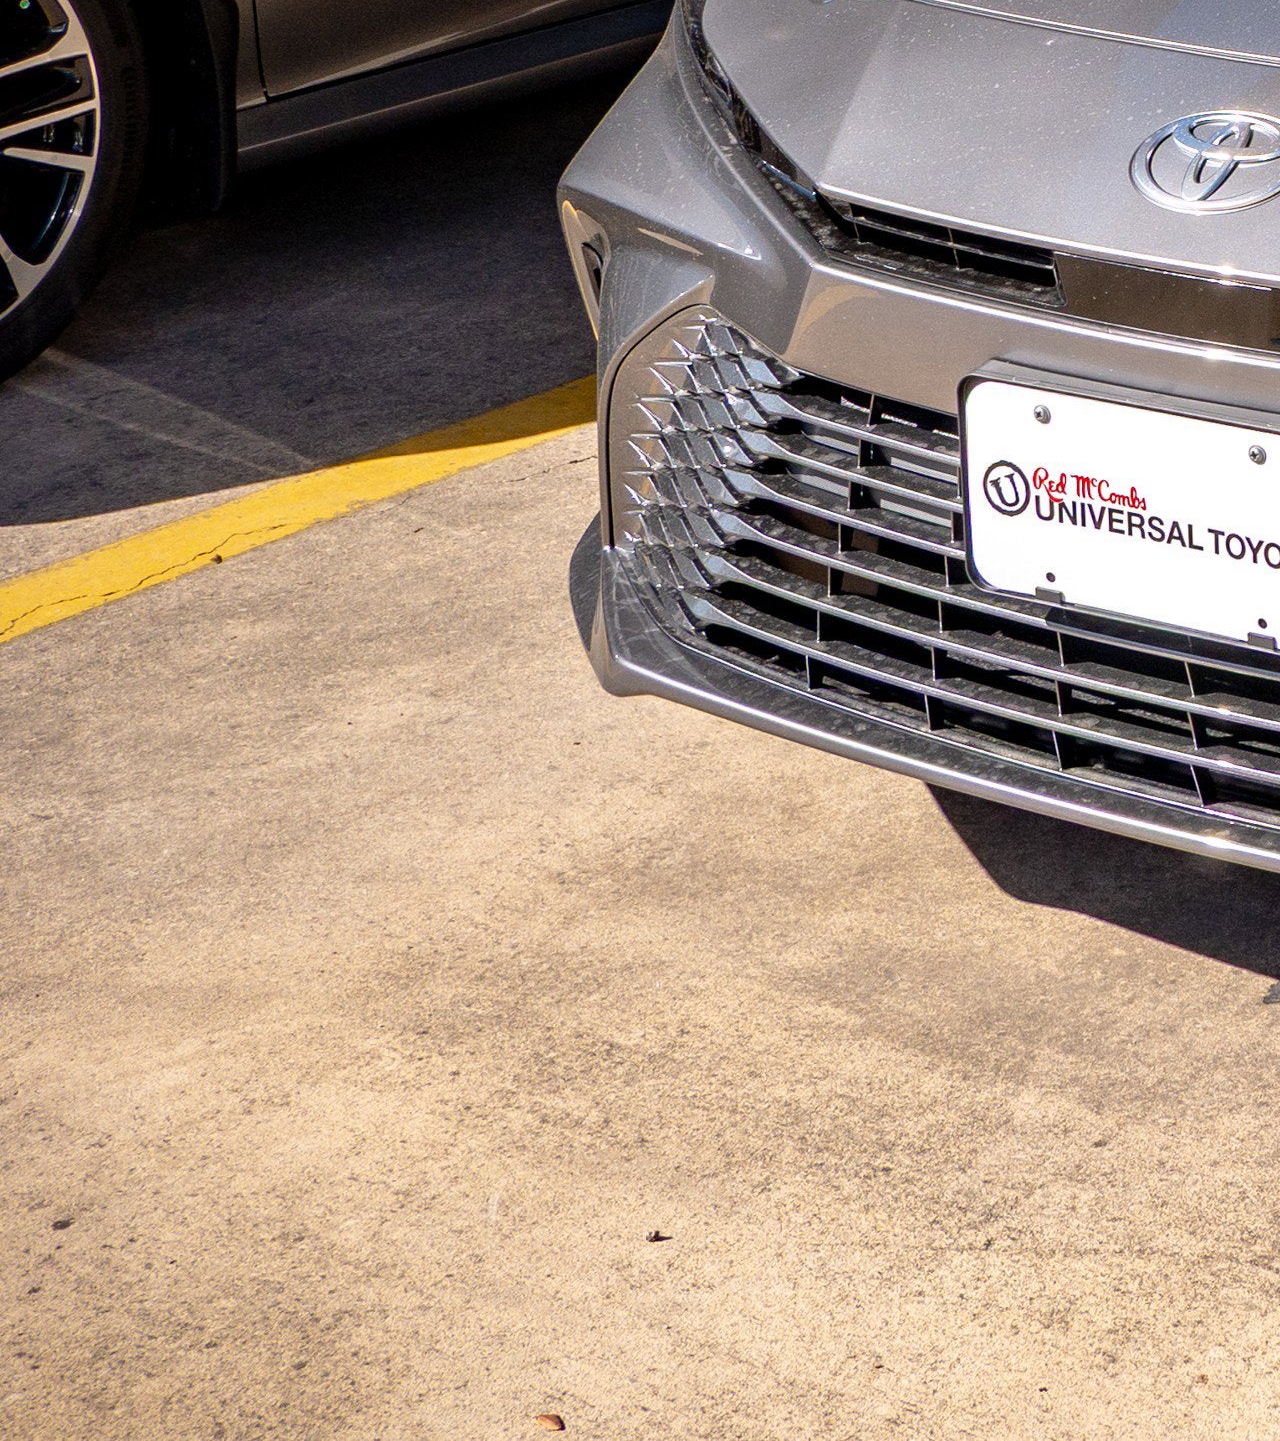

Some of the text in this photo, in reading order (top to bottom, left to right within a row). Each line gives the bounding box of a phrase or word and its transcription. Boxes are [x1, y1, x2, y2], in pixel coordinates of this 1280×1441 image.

[1032, 467, 1147, 511] Red McCombs
[1035, 494, 1204, 551] UNIVERSAL
